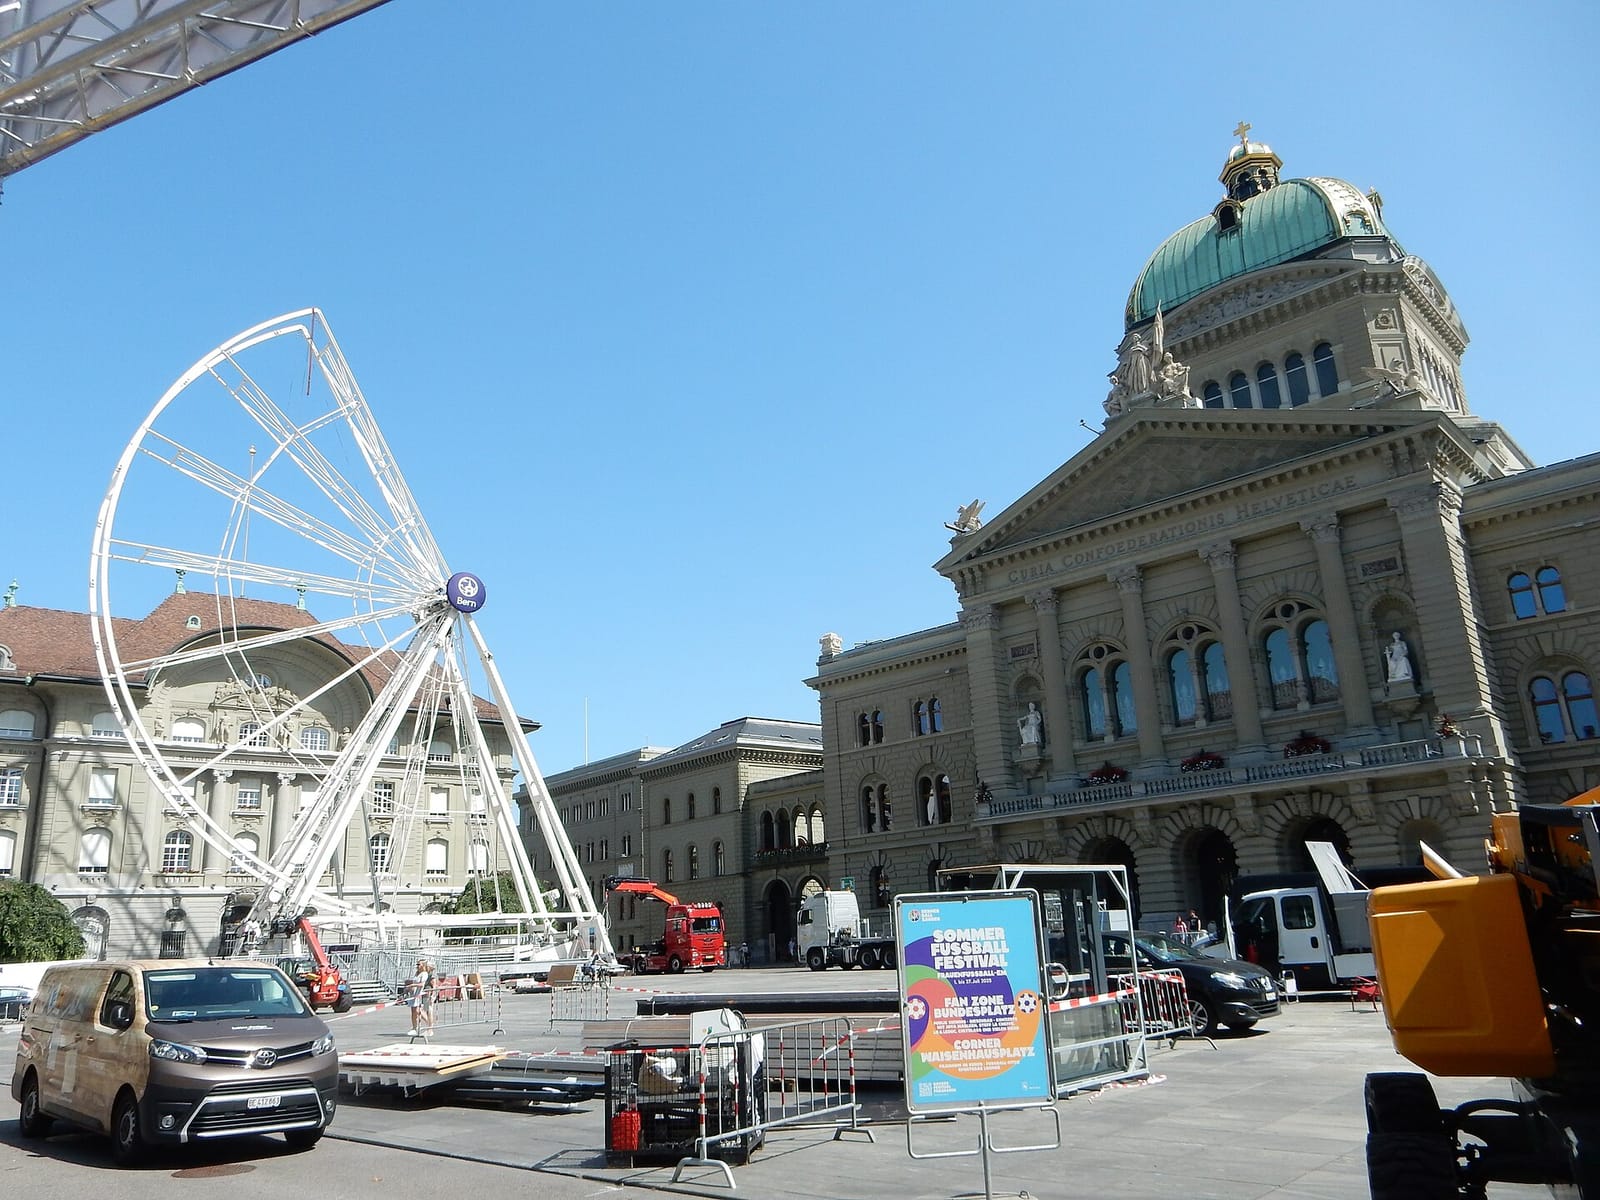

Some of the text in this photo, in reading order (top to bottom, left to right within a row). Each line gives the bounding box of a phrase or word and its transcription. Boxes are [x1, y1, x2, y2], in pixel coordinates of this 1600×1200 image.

[1062, 512, 1225, 568] CONFOEDERATIONIS
[1236, 475, 1357, 520] HELVETICAE
[456, 596, 477, 608] Bern
[933, 927, 1005, 943] SOMMER
[931, 940, 1009, 957] FUSSBALL
[934, 953, 1008, 970] FESTIVAL
[944, 995, 1004, 1007] FAN ZONE
[933, 1004, 1016, 1019] BUNDESPLATZ
[954, 1038, 1001, 1050] CORNER
[920, 1046, 1035, 1063] WAISENHAUSPLATZ
